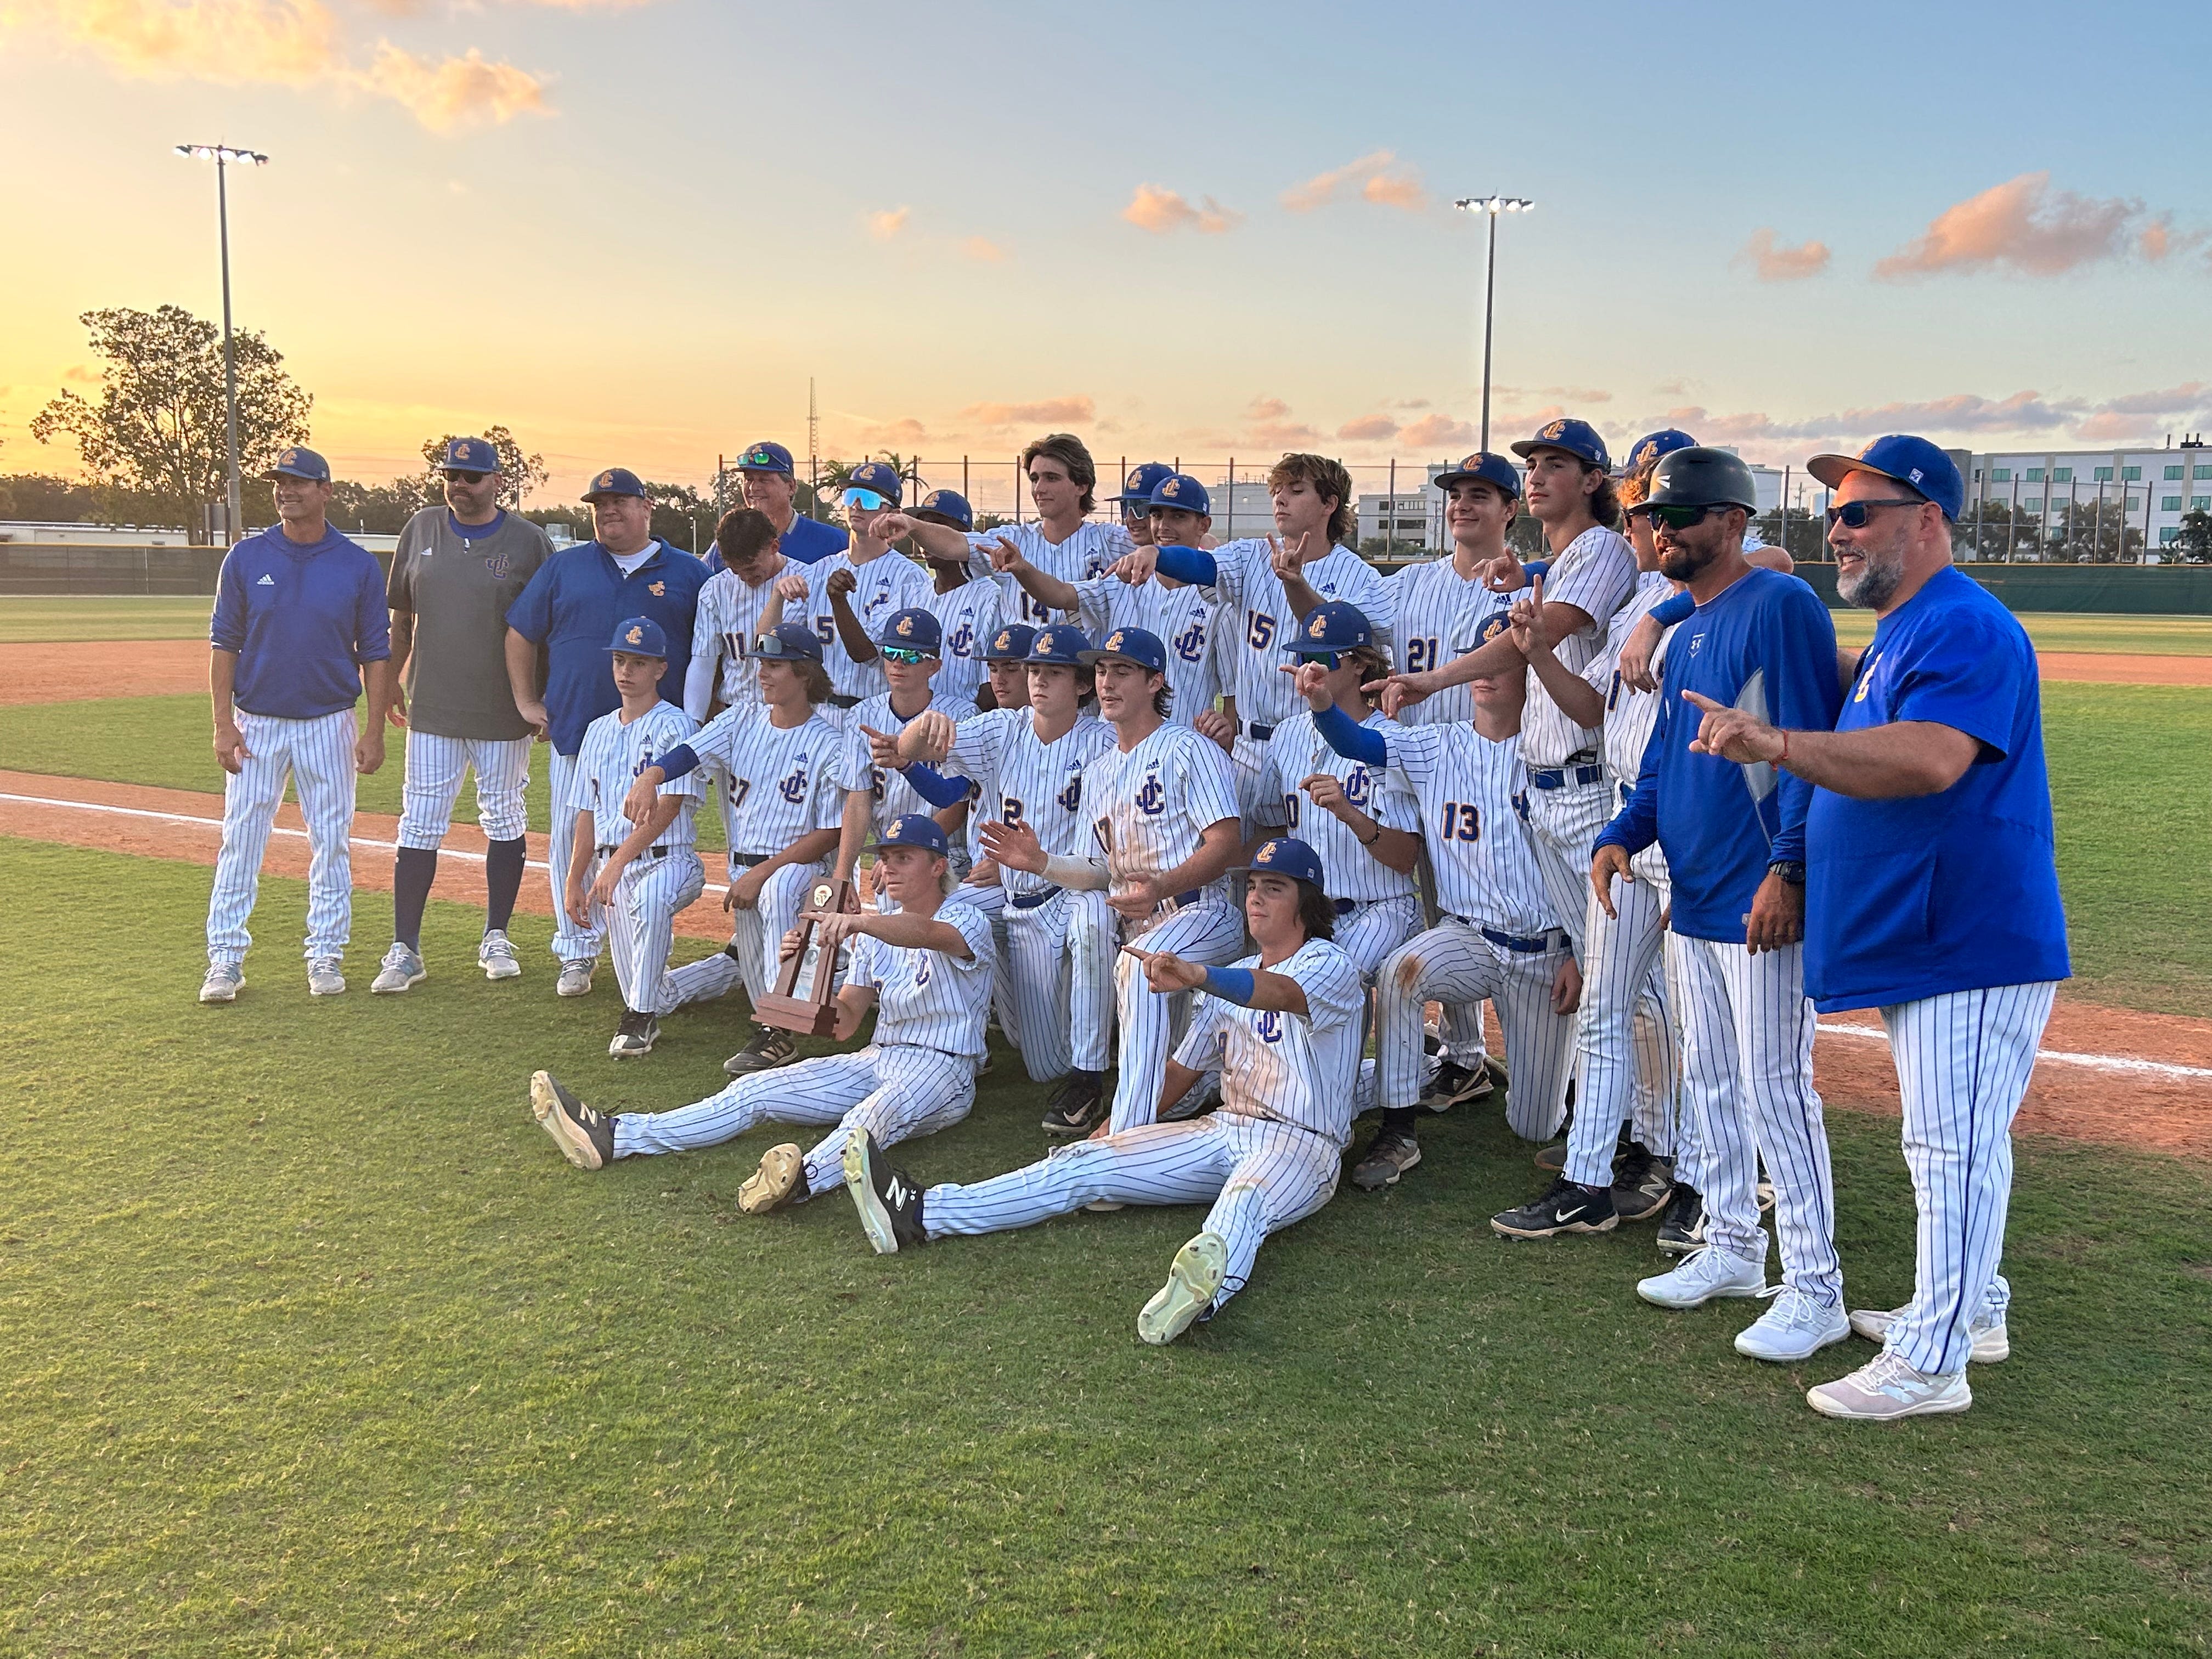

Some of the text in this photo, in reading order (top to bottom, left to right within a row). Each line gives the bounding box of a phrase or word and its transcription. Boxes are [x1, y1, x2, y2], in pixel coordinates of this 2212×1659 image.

[1543, 420, 1566, 440] JC
[1161, 475, 1181, 498] JC
[485, 553, 509, 580] JC
[1021, 591, 1049, 623] 14
[816, 616, 834, 645] 5
[950, 622, 974, 658] JC
[1105, 631, 1124, 652] JC
[1174, 622, 1206, 663] JC
[1247, 610, 1276, 650] 15
[1308, 614, 1326, 639] JC
[726, 632, 745, 661] 11
[1408, 637, 1438, 674] 21
[780, 768, 808, 804] JC
[1135, 771, 1165, 816] JC
[1336, 765, 1370, 807] JC
[1441, 800, 1480, 843] 13
[1256, 842, 1277, 864] JC
